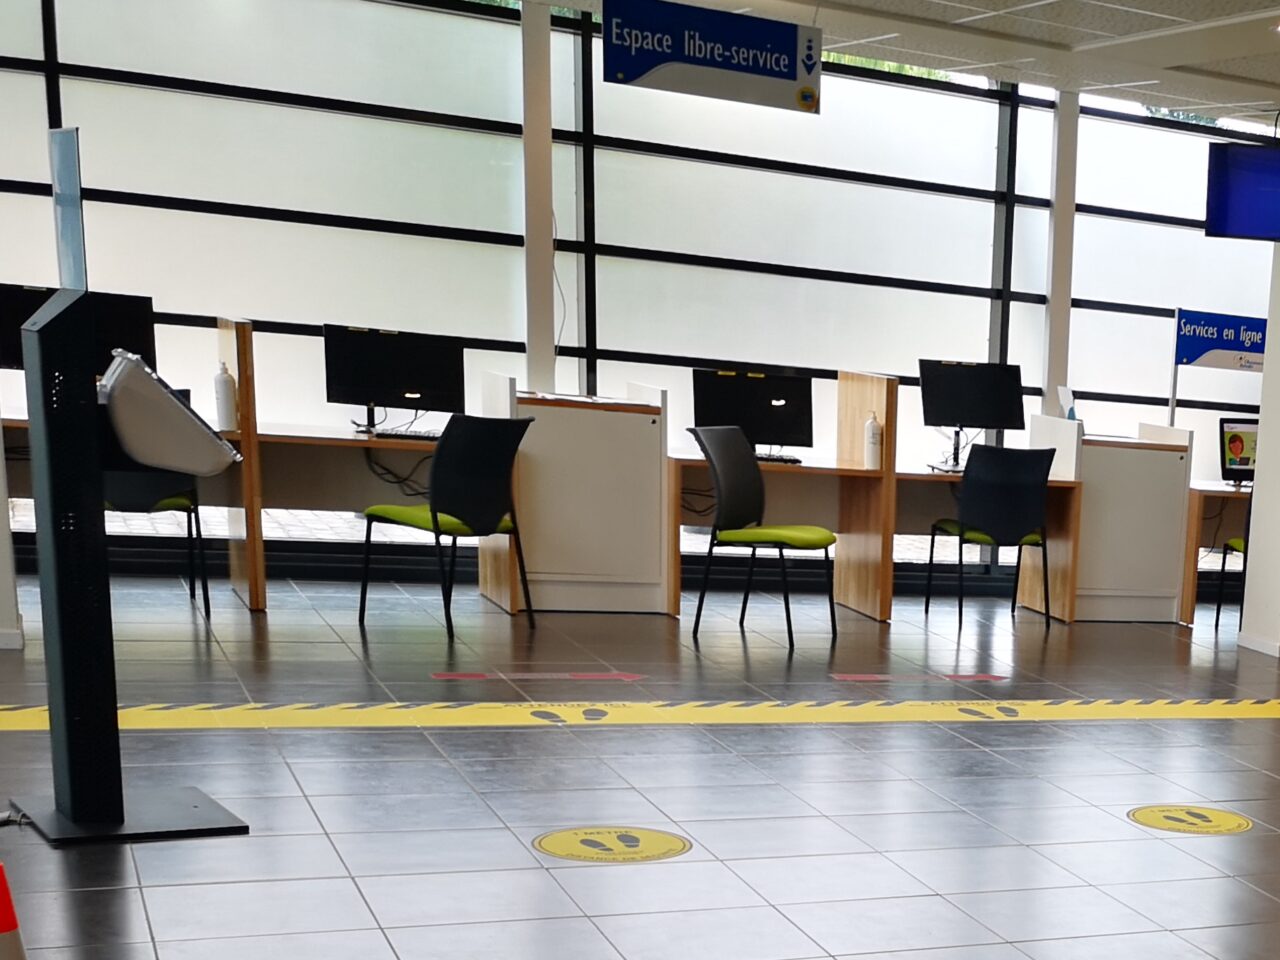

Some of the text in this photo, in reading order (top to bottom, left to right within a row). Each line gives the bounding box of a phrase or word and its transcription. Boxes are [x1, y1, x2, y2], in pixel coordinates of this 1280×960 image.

[611, 17, 789, 73] Espace libre-service
[1180, 318, 1263, 348] Services en ligne
